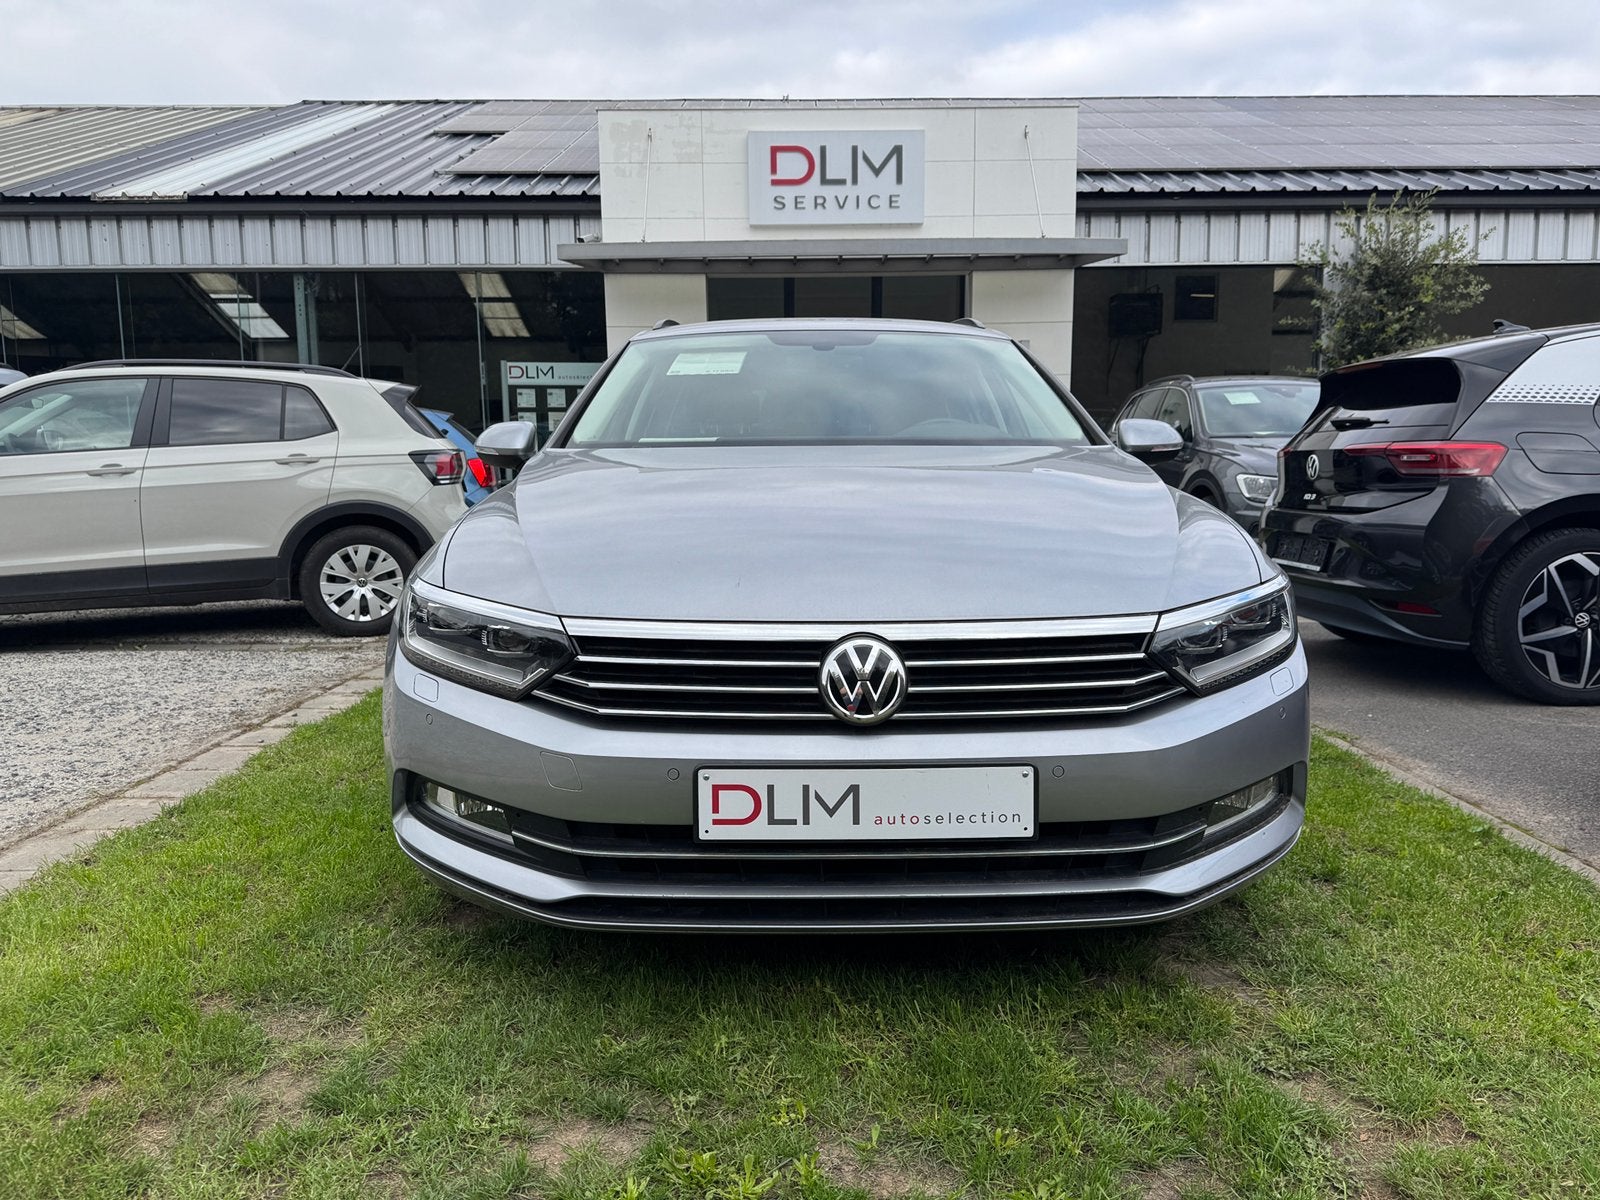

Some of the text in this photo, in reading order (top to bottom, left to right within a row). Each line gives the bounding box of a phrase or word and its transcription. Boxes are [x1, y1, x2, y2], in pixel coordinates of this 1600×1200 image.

[770, 144, 903, 186] DLM
[773, 194, 901, 210] SERVICE
[508, 365, 555, 380] DLM
[711, 783, 1022, 826] DLM autoselection
